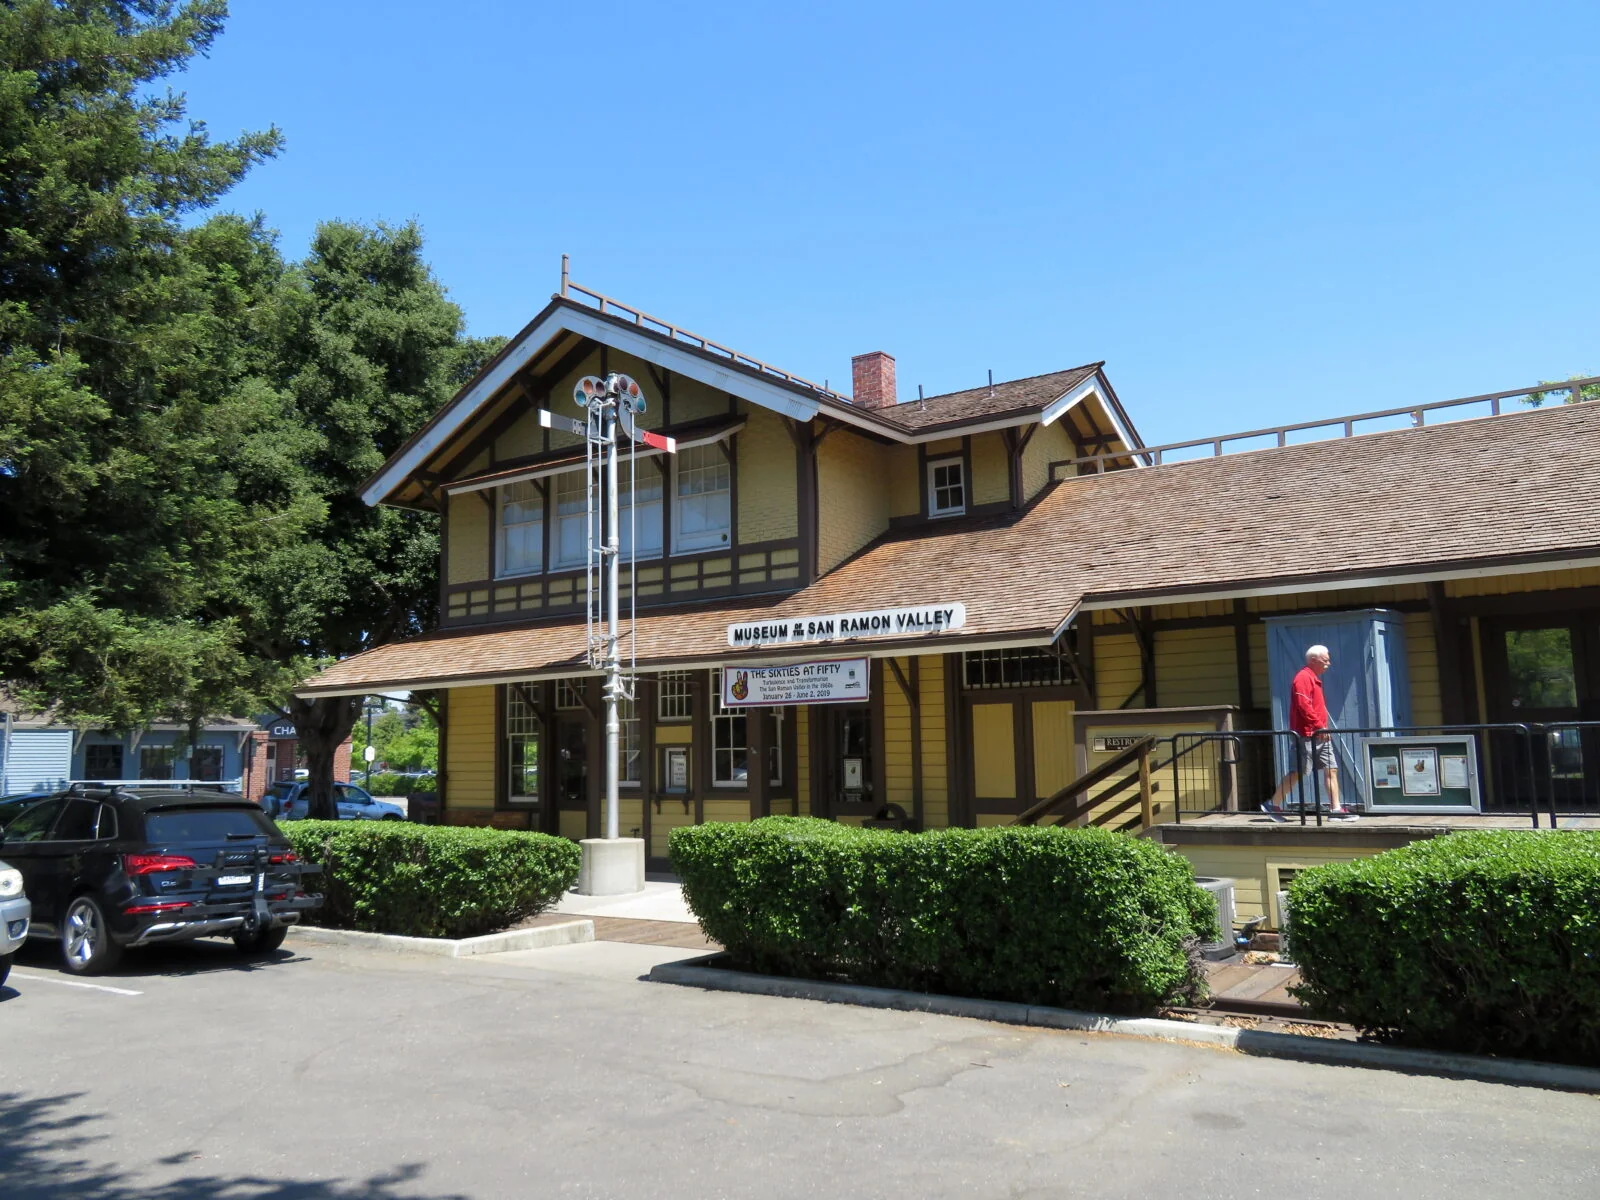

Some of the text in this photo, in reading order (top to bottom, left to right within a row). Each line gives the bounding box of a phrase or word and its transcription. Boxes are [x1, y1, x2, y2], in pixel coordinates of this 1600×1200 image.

[734, 624, 788, 641] MUSEUM
[808, 618, 834, 635] SAN
[841, 615, 890, 632] RAMON
[897, 610, 953, 628] VALLEY
[751, 670, 766, 678] THE
[768, 667, 800, 678] SIXTIES
[803, 666, 815, 675] AT
[817, 664, 840, 674] FIFTY
